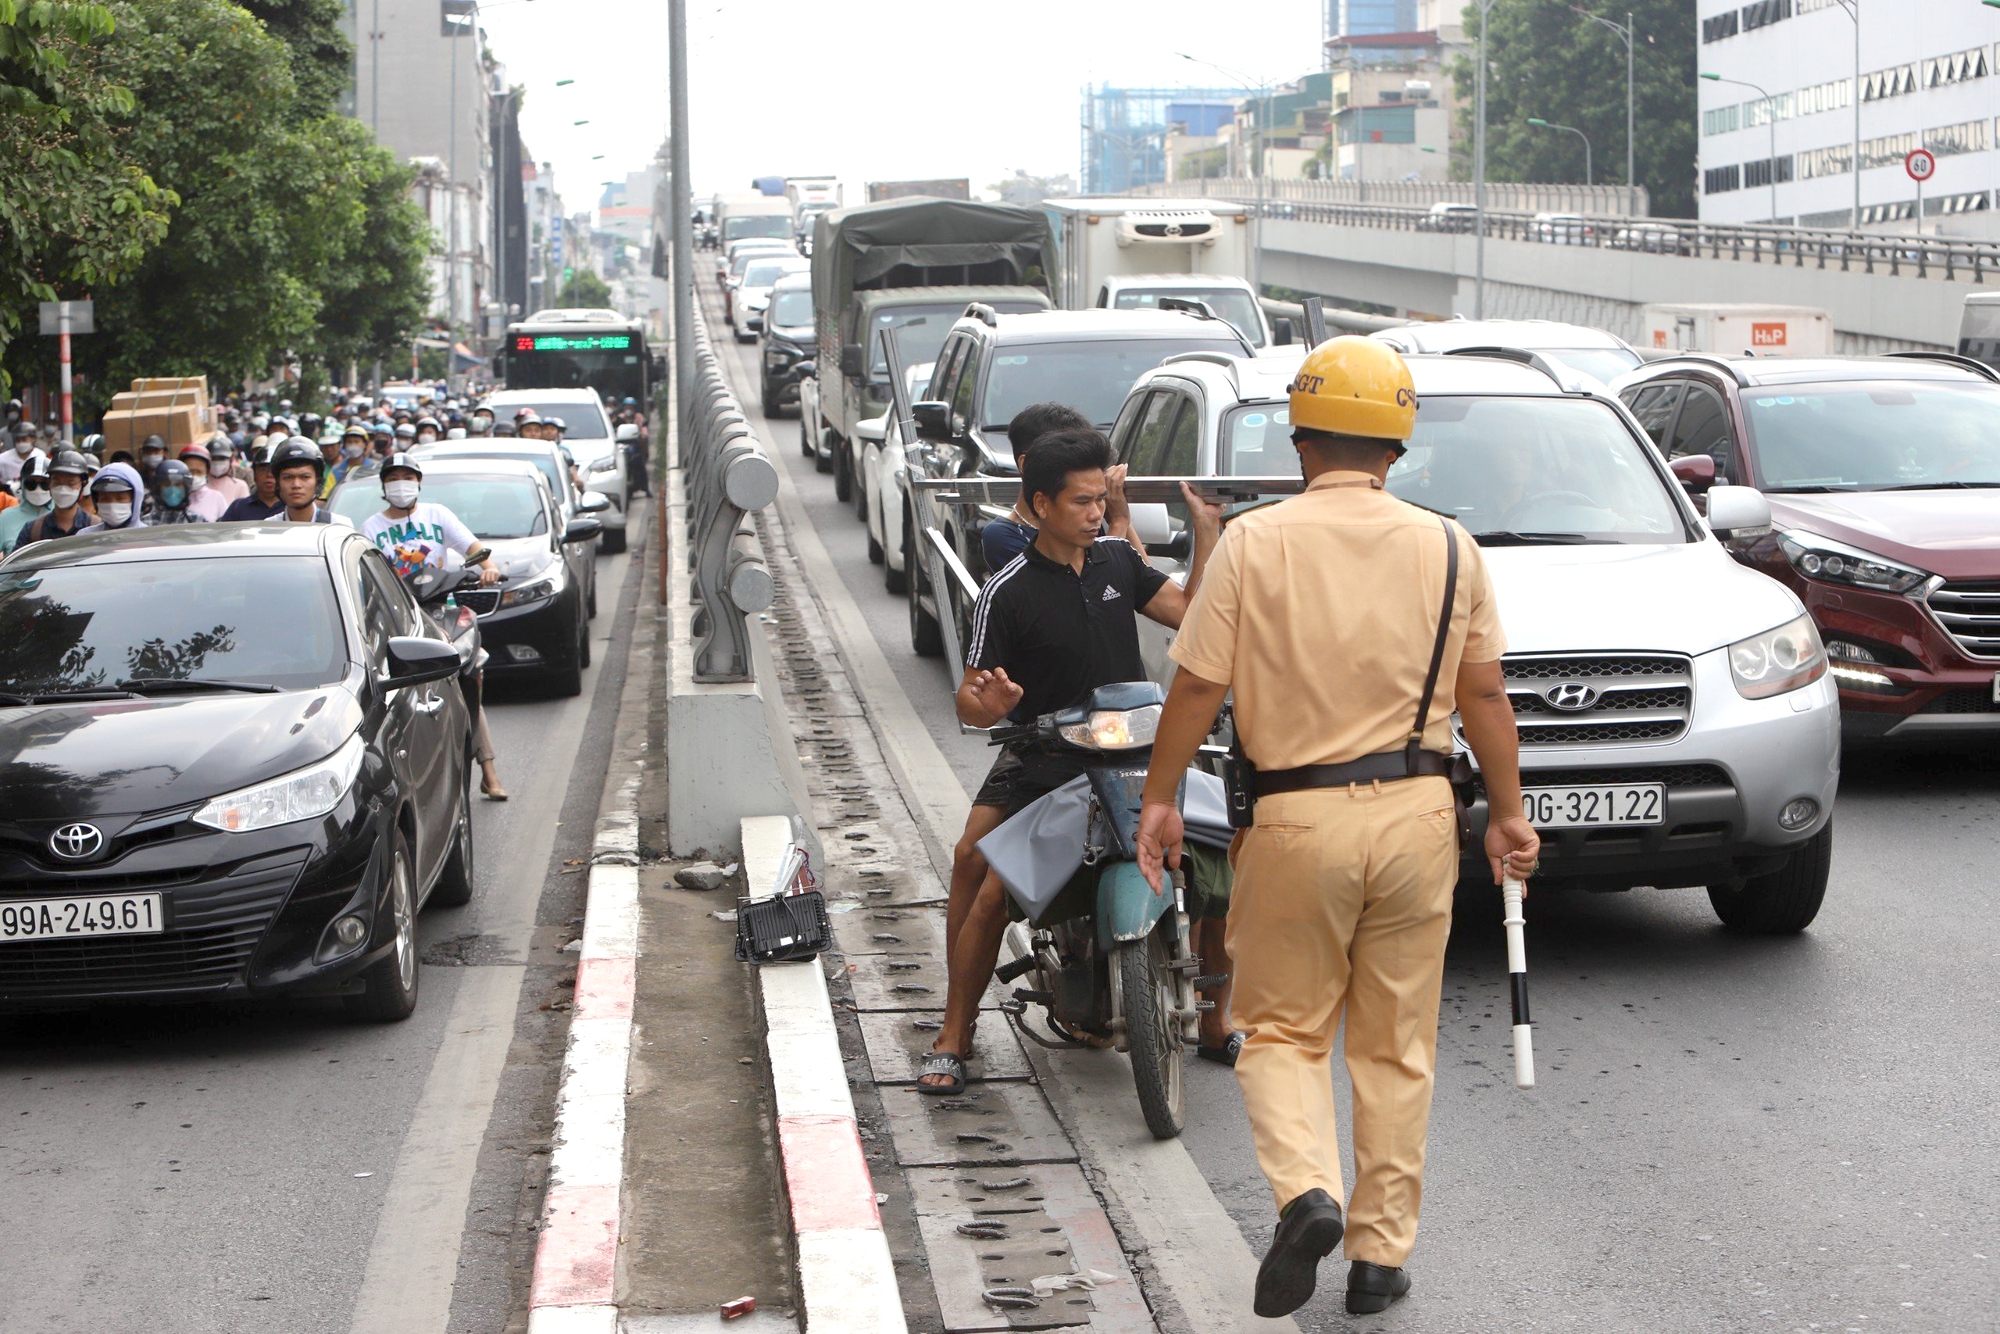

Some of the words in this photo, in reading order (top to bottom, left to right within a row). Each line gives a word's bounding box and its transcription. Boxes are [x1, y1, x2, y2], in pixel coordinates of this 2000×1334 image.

[1913, 159, 1927, 172] 60
[1754, 329, 1784, 344] H&P
[1292, 374, 1324, 394] SGT
[375, 521, 444, 550] ONALD
[1102, 592, 1121, 602] adidas
[1522, 789, 1659, 824] 0G-321.22
[2, 898, 153, 937] 99A-249.61
